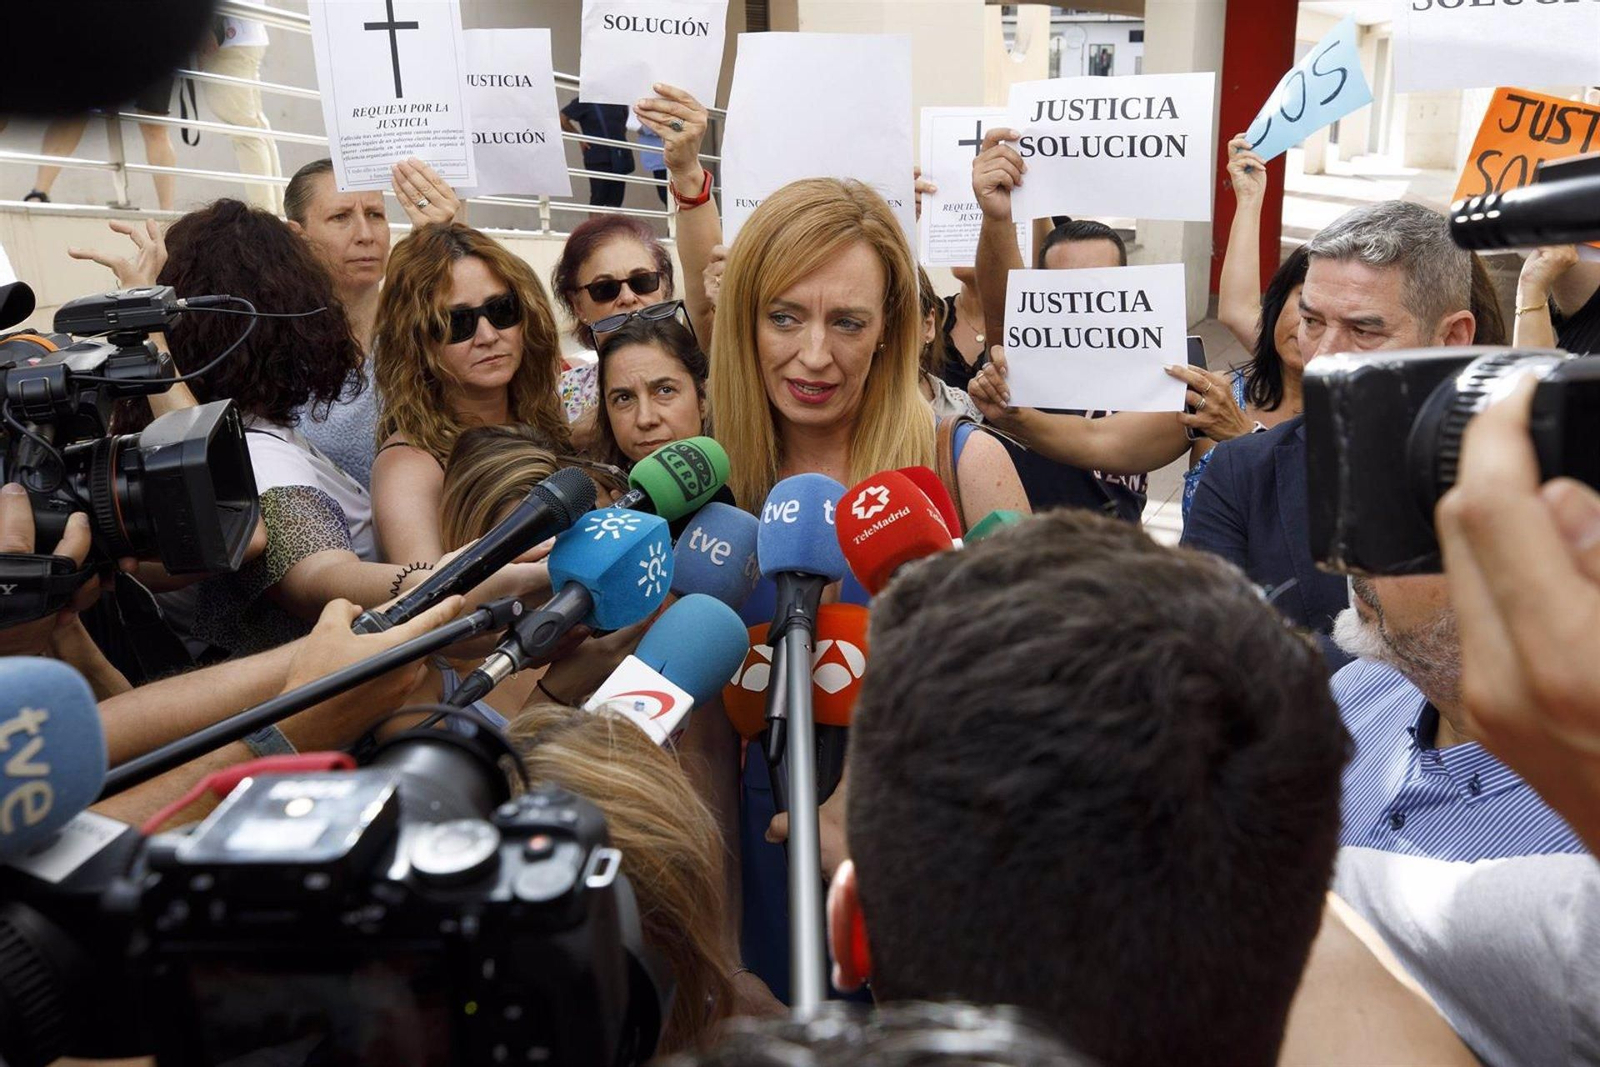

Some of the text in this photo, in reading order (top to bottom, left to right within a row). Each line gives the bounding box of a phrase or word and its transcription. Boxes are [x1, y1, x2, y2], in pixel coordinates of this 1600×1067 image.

[603, 14, 710, 37] SOLUCIÓN
[352, 103, 449, 119] REQUIEM POR LA
[1030, 96, 1180, 122] JUSTICIA
[376, 118, 429, 130] JUSTICIA
[471, 128, 546, 145] OLUCIÓN
[1019, 134, 1189, 158] SOLUCION
[1017, 289, 1154, 314] JUSTICIA
[1008, 326, 1164, 349] SOLUCION
[666, 453, 698, 490] CERO
[764, 499, 800, 524] tve
[853, 506, 911, 545] TeleMadrid
[688, 526, 732, 567] tve
[0, 706, 54, 835] tve
